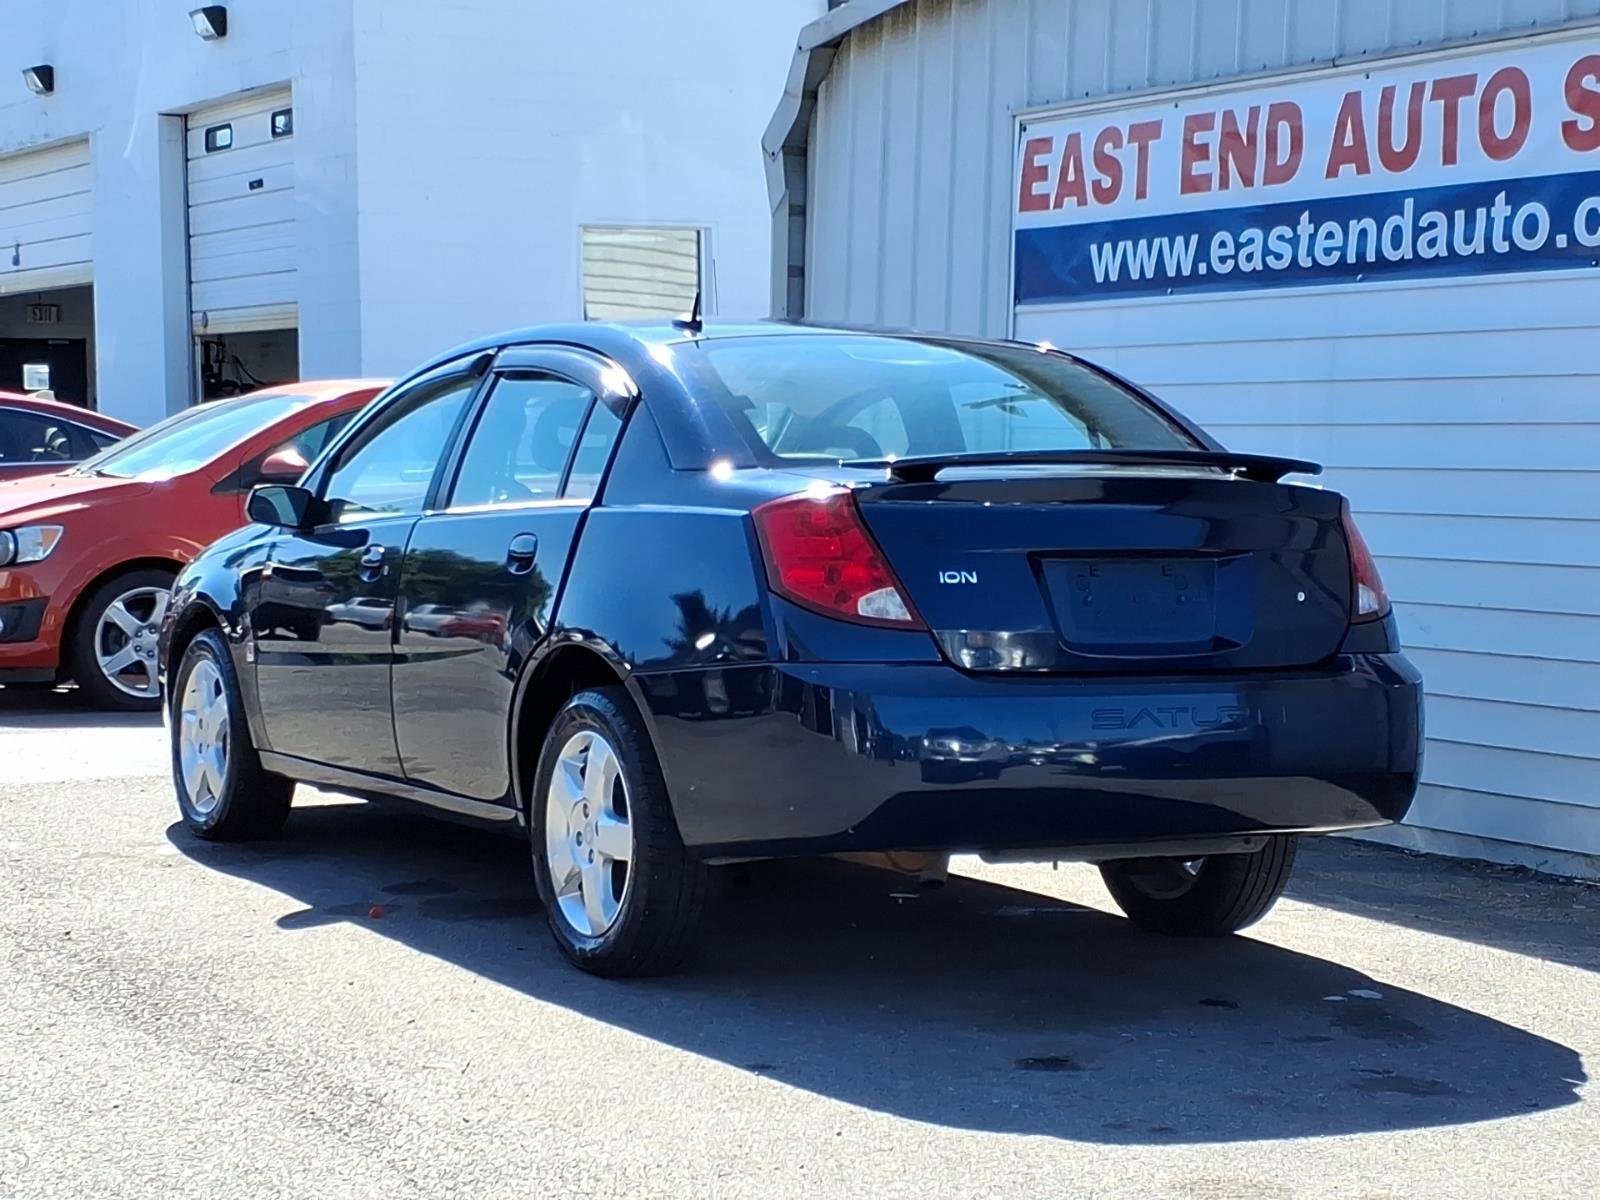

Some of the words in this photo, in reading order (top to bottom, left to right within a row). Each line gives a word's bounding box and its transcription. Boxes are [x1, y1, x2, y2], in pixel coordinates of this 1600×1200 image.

[1018, 119, 1163, 213] EAST
[1180, 101, 1304, 196] END
[1325, 66, 1532, 180] AUTO
[938, 570, 978, 584] ION
